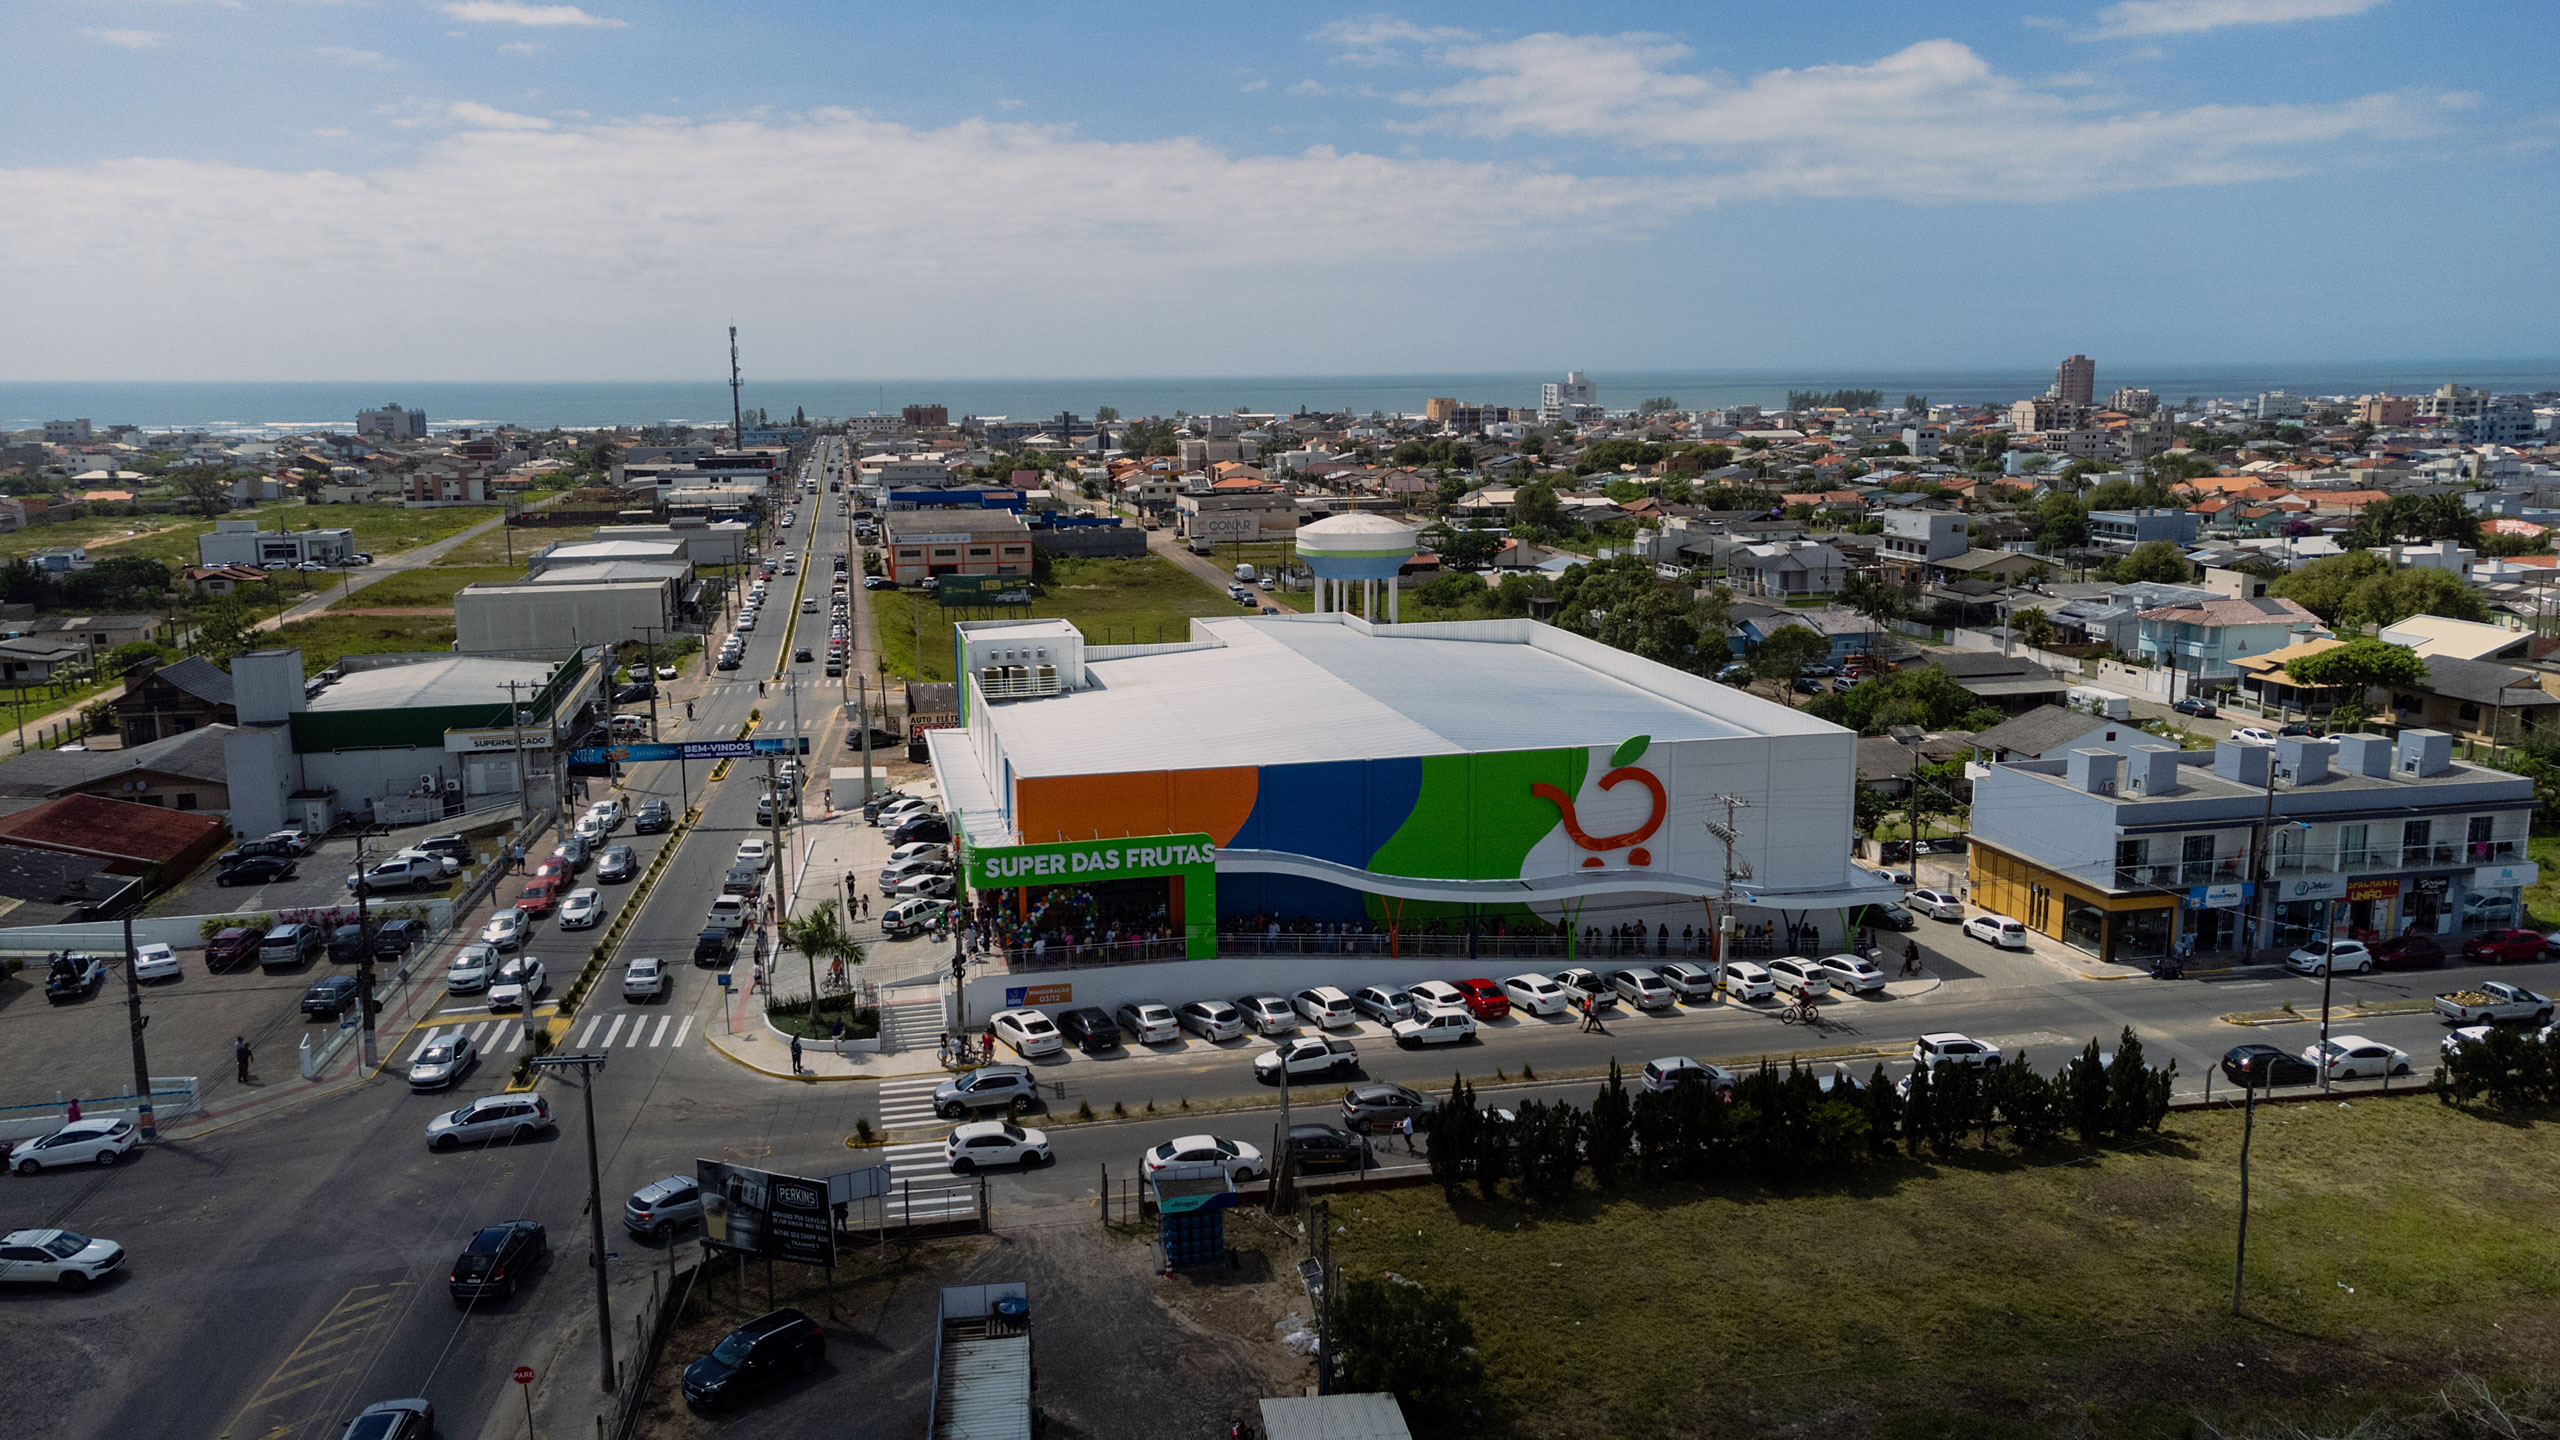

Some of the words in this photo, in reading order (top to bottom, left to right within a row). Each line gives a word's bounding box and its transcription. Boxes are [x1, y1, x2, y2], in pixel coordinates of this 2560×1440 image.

[1209, 520, 1251, 531] CONAR
[684, 743, 751, 753] BEM-VINDOS
[985, 854, 1066, 878] SUPER
[1071, 849, 1120, 873] DAS
[1126, 843, 1216, 869] FRUTAS
[2351, 888, 2382, 900] UNIÃO
[1029, 987, 1070, 995] INAUGURAÇÃO
[780, 1187, 815, 1204] PERKINS
